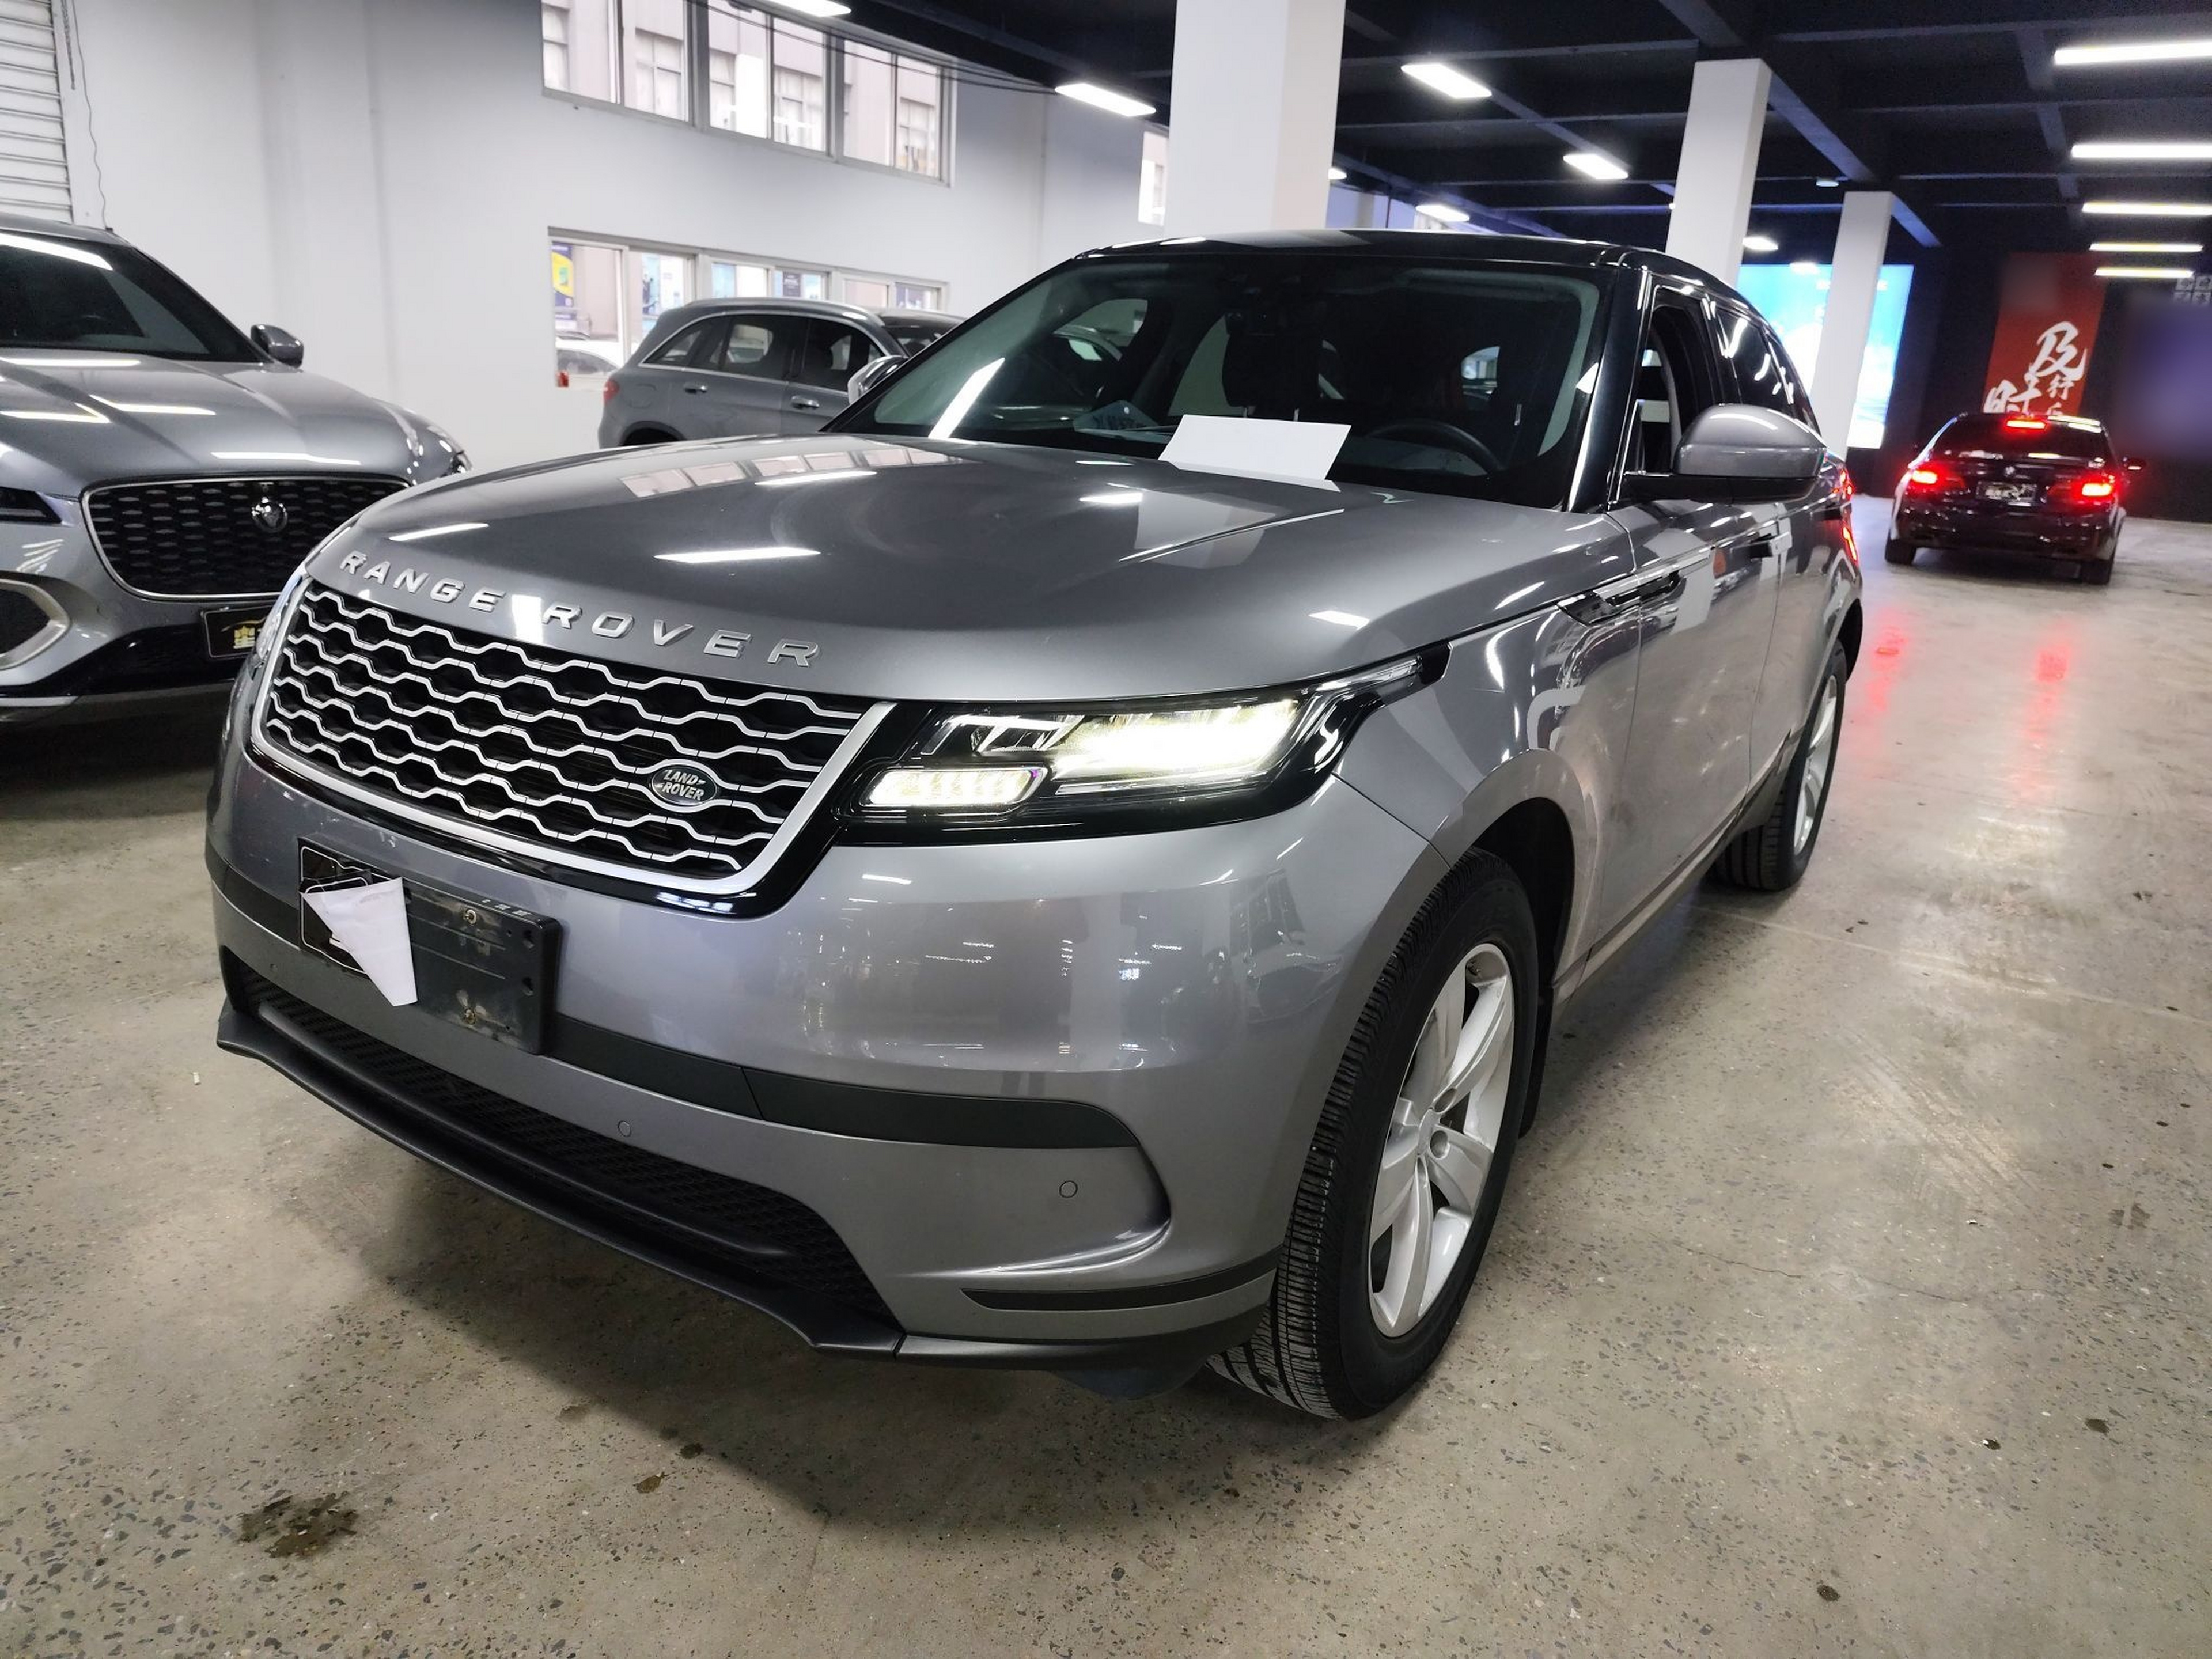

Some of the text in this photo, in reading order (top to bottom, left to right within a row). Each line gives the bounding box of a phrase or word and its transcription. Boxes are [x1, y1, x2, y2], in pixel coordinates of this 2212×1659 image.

[339, 550, 818, 667] RANGE ROVER
[663, 770, 699, 785] LAND
[662, 781, 704, 801] ROVER
